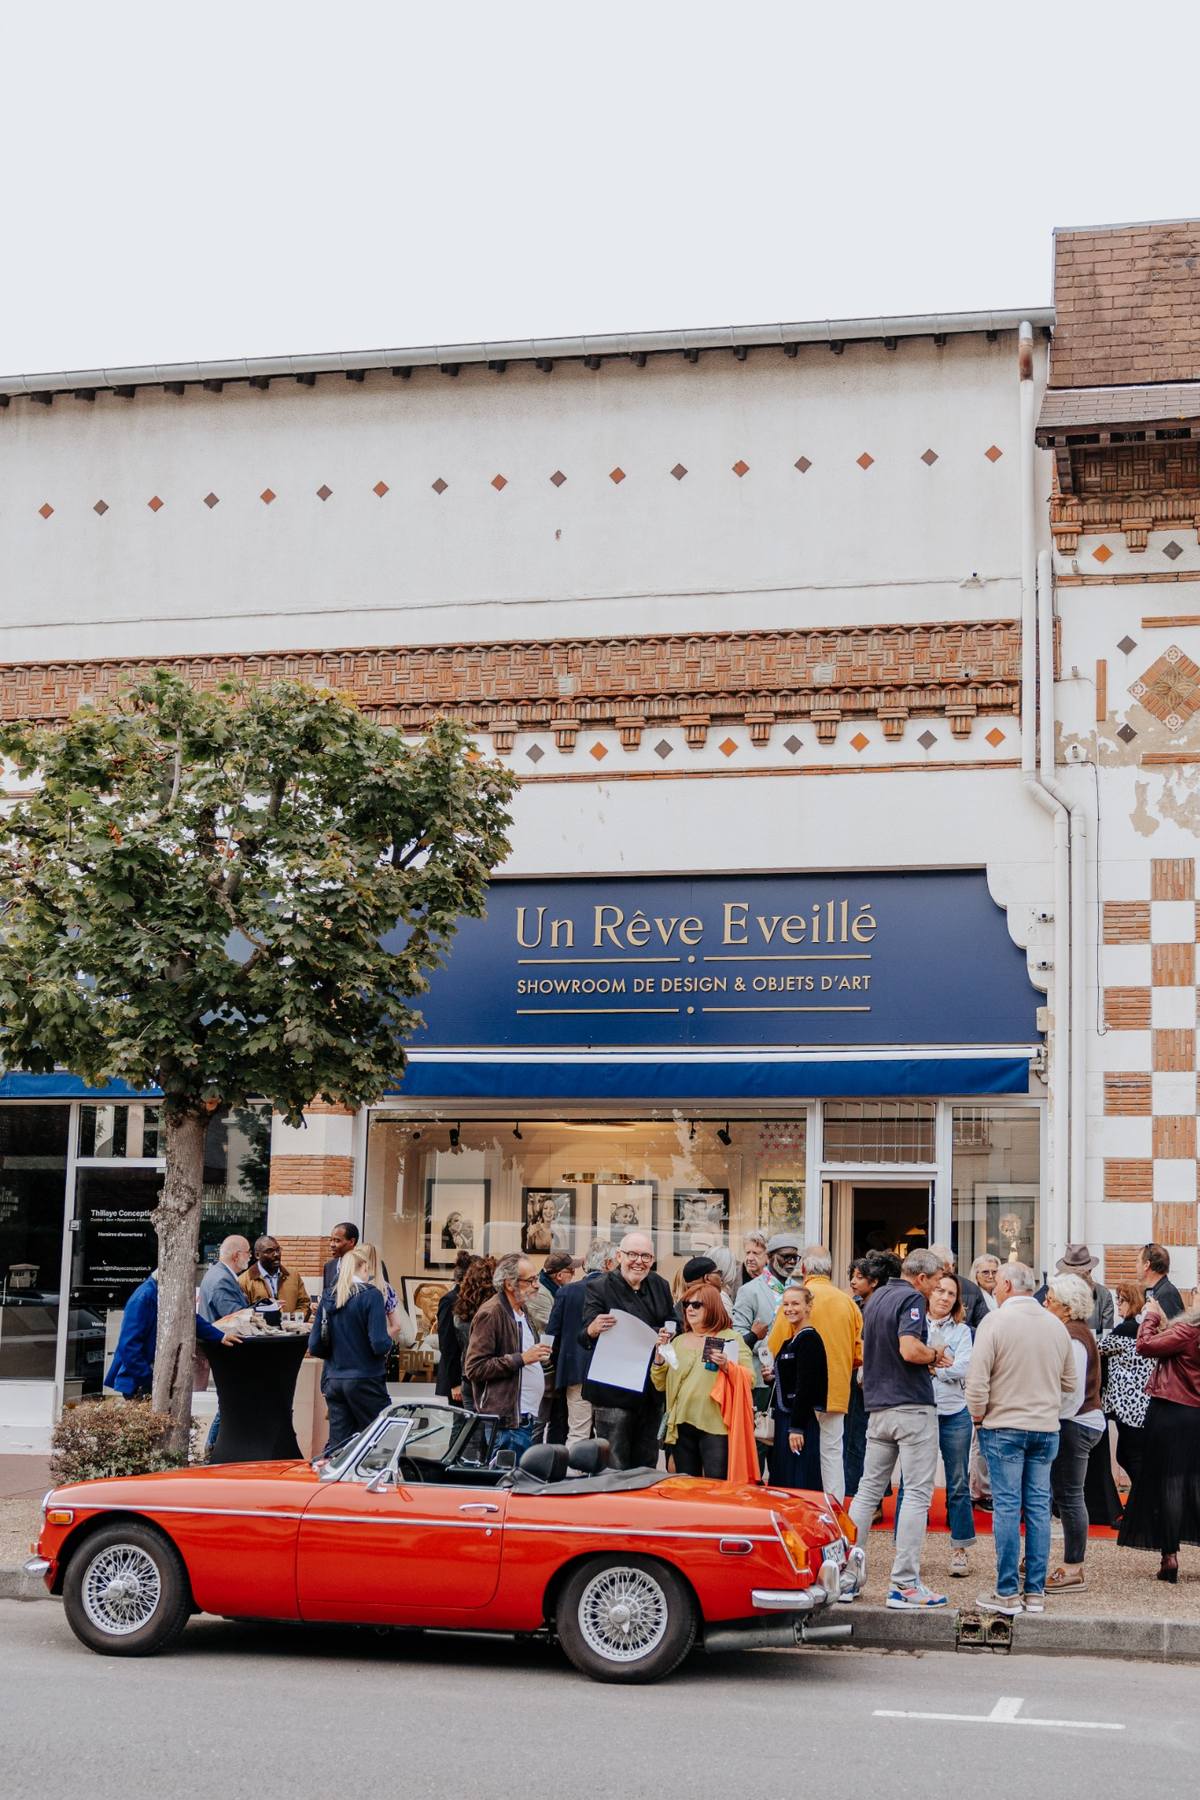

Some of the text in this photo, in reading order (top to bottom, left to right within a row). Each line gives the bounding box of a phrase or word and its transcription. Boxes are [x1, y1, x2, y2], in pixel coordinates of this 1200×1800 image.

[516, 899, 878, 950] Un Rêve Eveillé
[517, 975, 872, 994] SHOWROOM DE DESIGN & OBJETS D'ART
[91, 1209, 118, 1218] Thillaye
